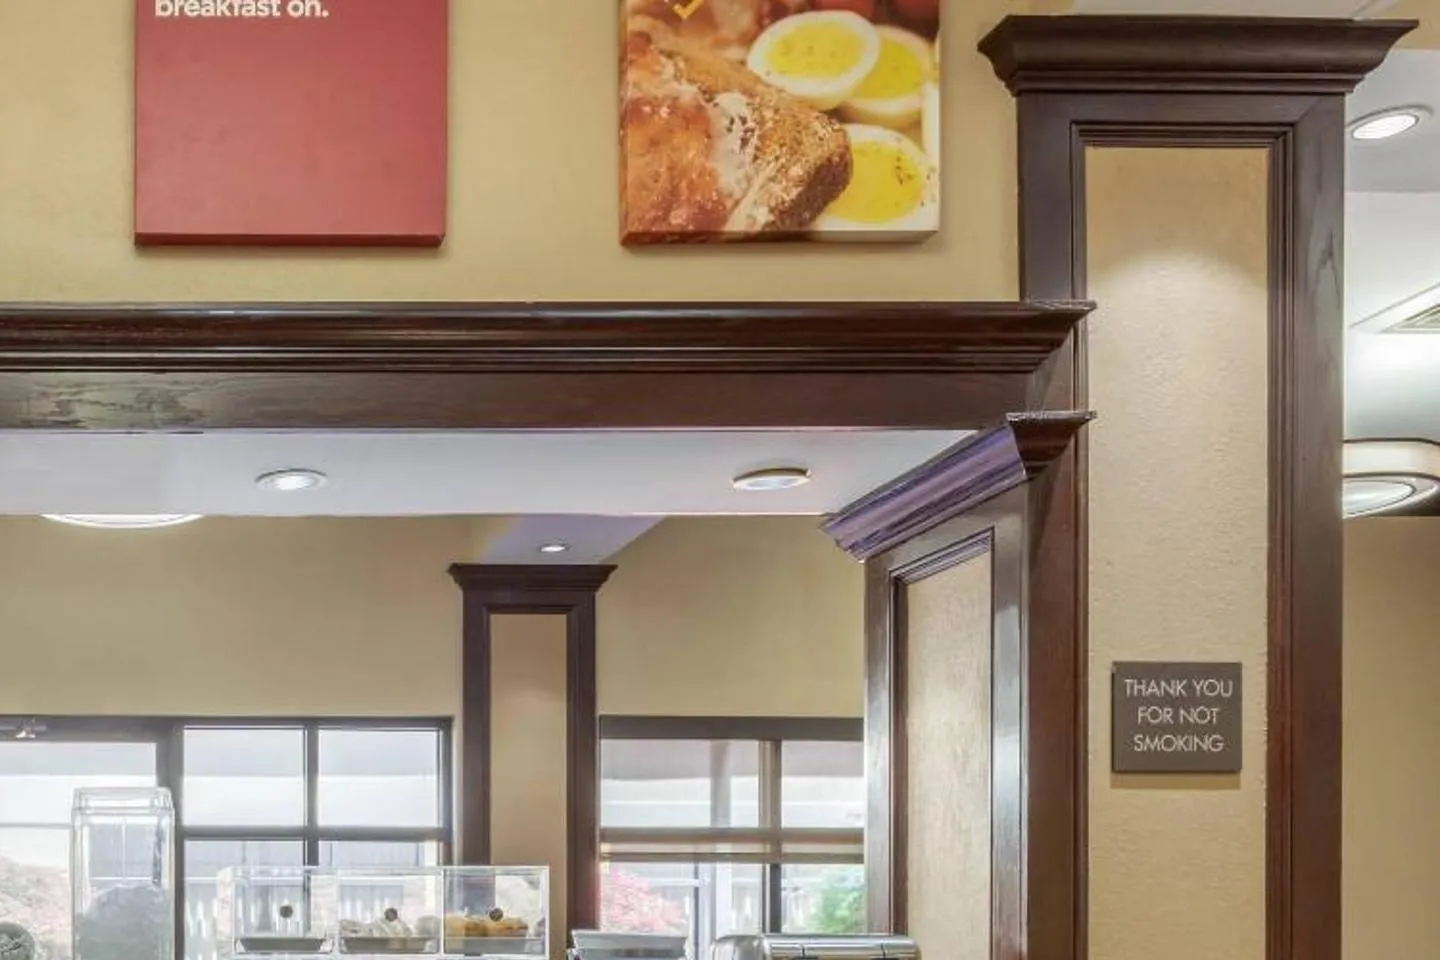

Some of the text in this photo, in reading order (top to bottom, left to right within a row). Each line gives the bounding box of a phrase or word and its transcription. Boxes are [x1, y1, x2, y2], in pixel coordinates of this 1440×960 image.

[154, 0, 329, 18] breakfast on.
[1124, 678, 1234, 698] THANK YOU
[1137, 705, 1220, 725] FOR NOT
[1133, 734, 1224, 753] SMOKING
